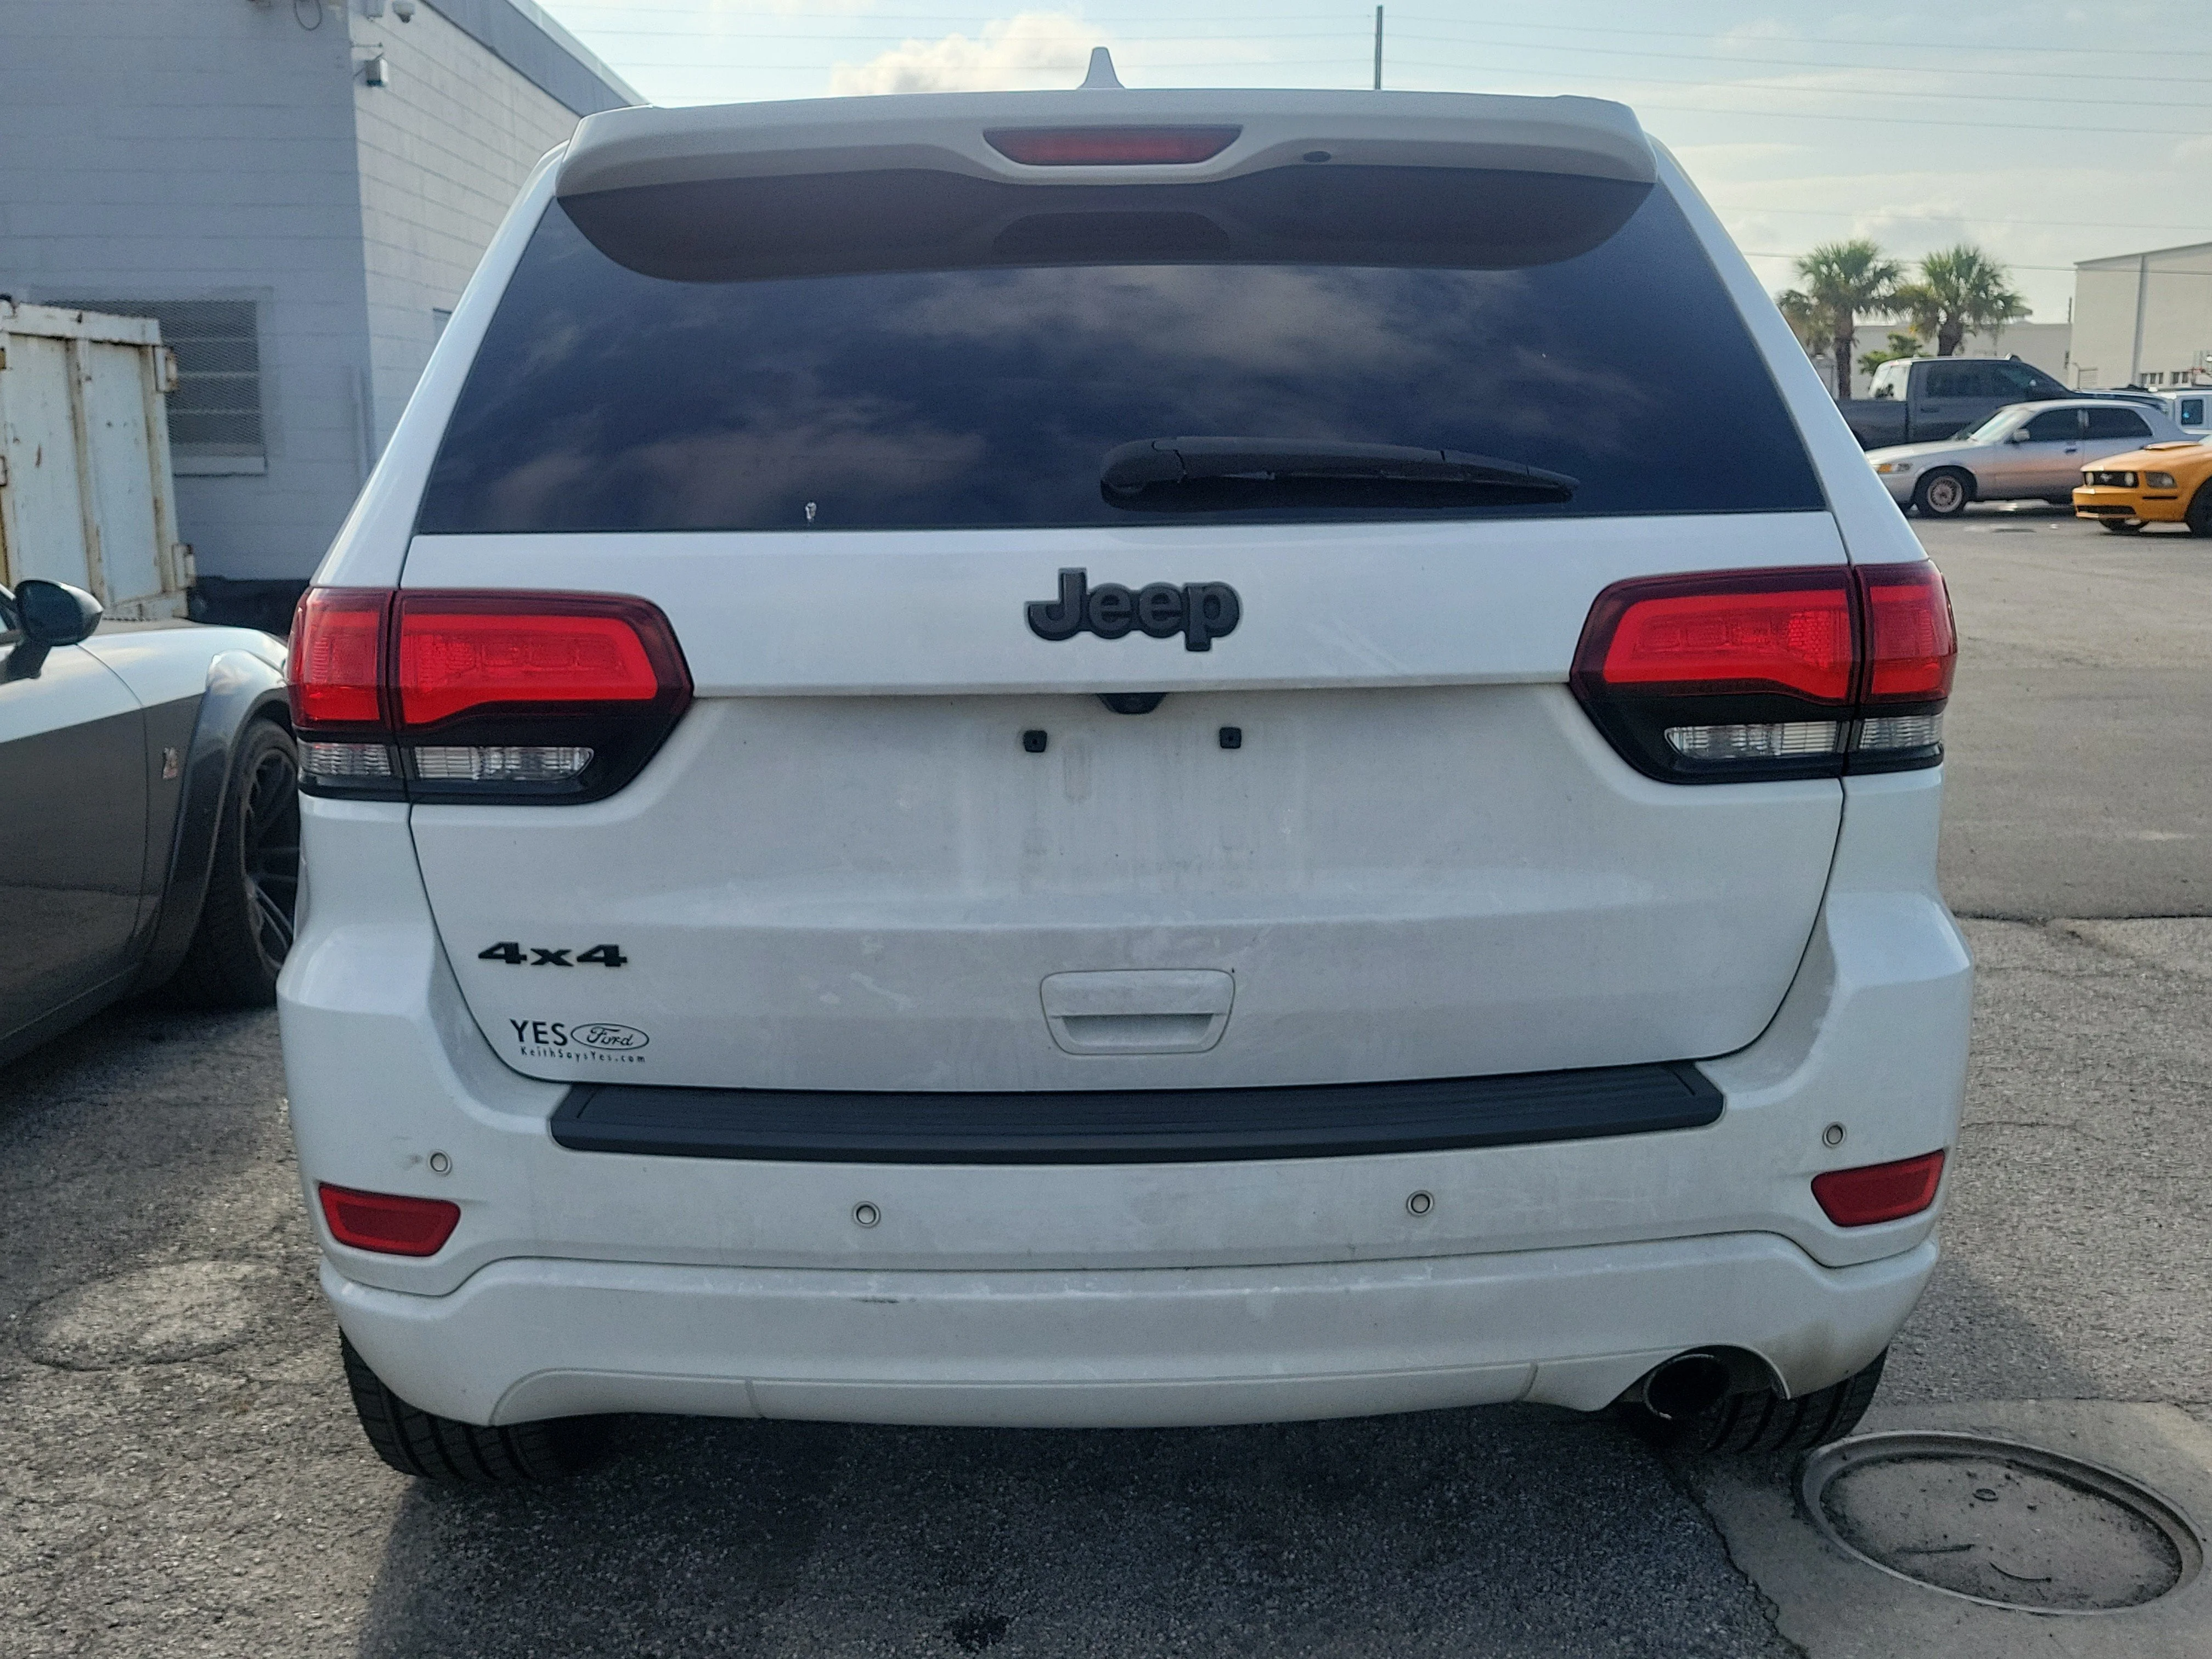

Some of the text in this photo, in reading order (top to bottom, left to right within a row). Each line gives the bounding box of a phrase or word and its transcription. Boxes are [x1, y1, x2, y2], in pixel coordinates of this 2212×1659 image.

[1024, 567, 1242, 651] Jeep
[478, 941, 627, 967] 4x4
[510, 1019, 634, 1046] YES Ford
[521, 1046, 646, 1063] KeithSaysYes.com
